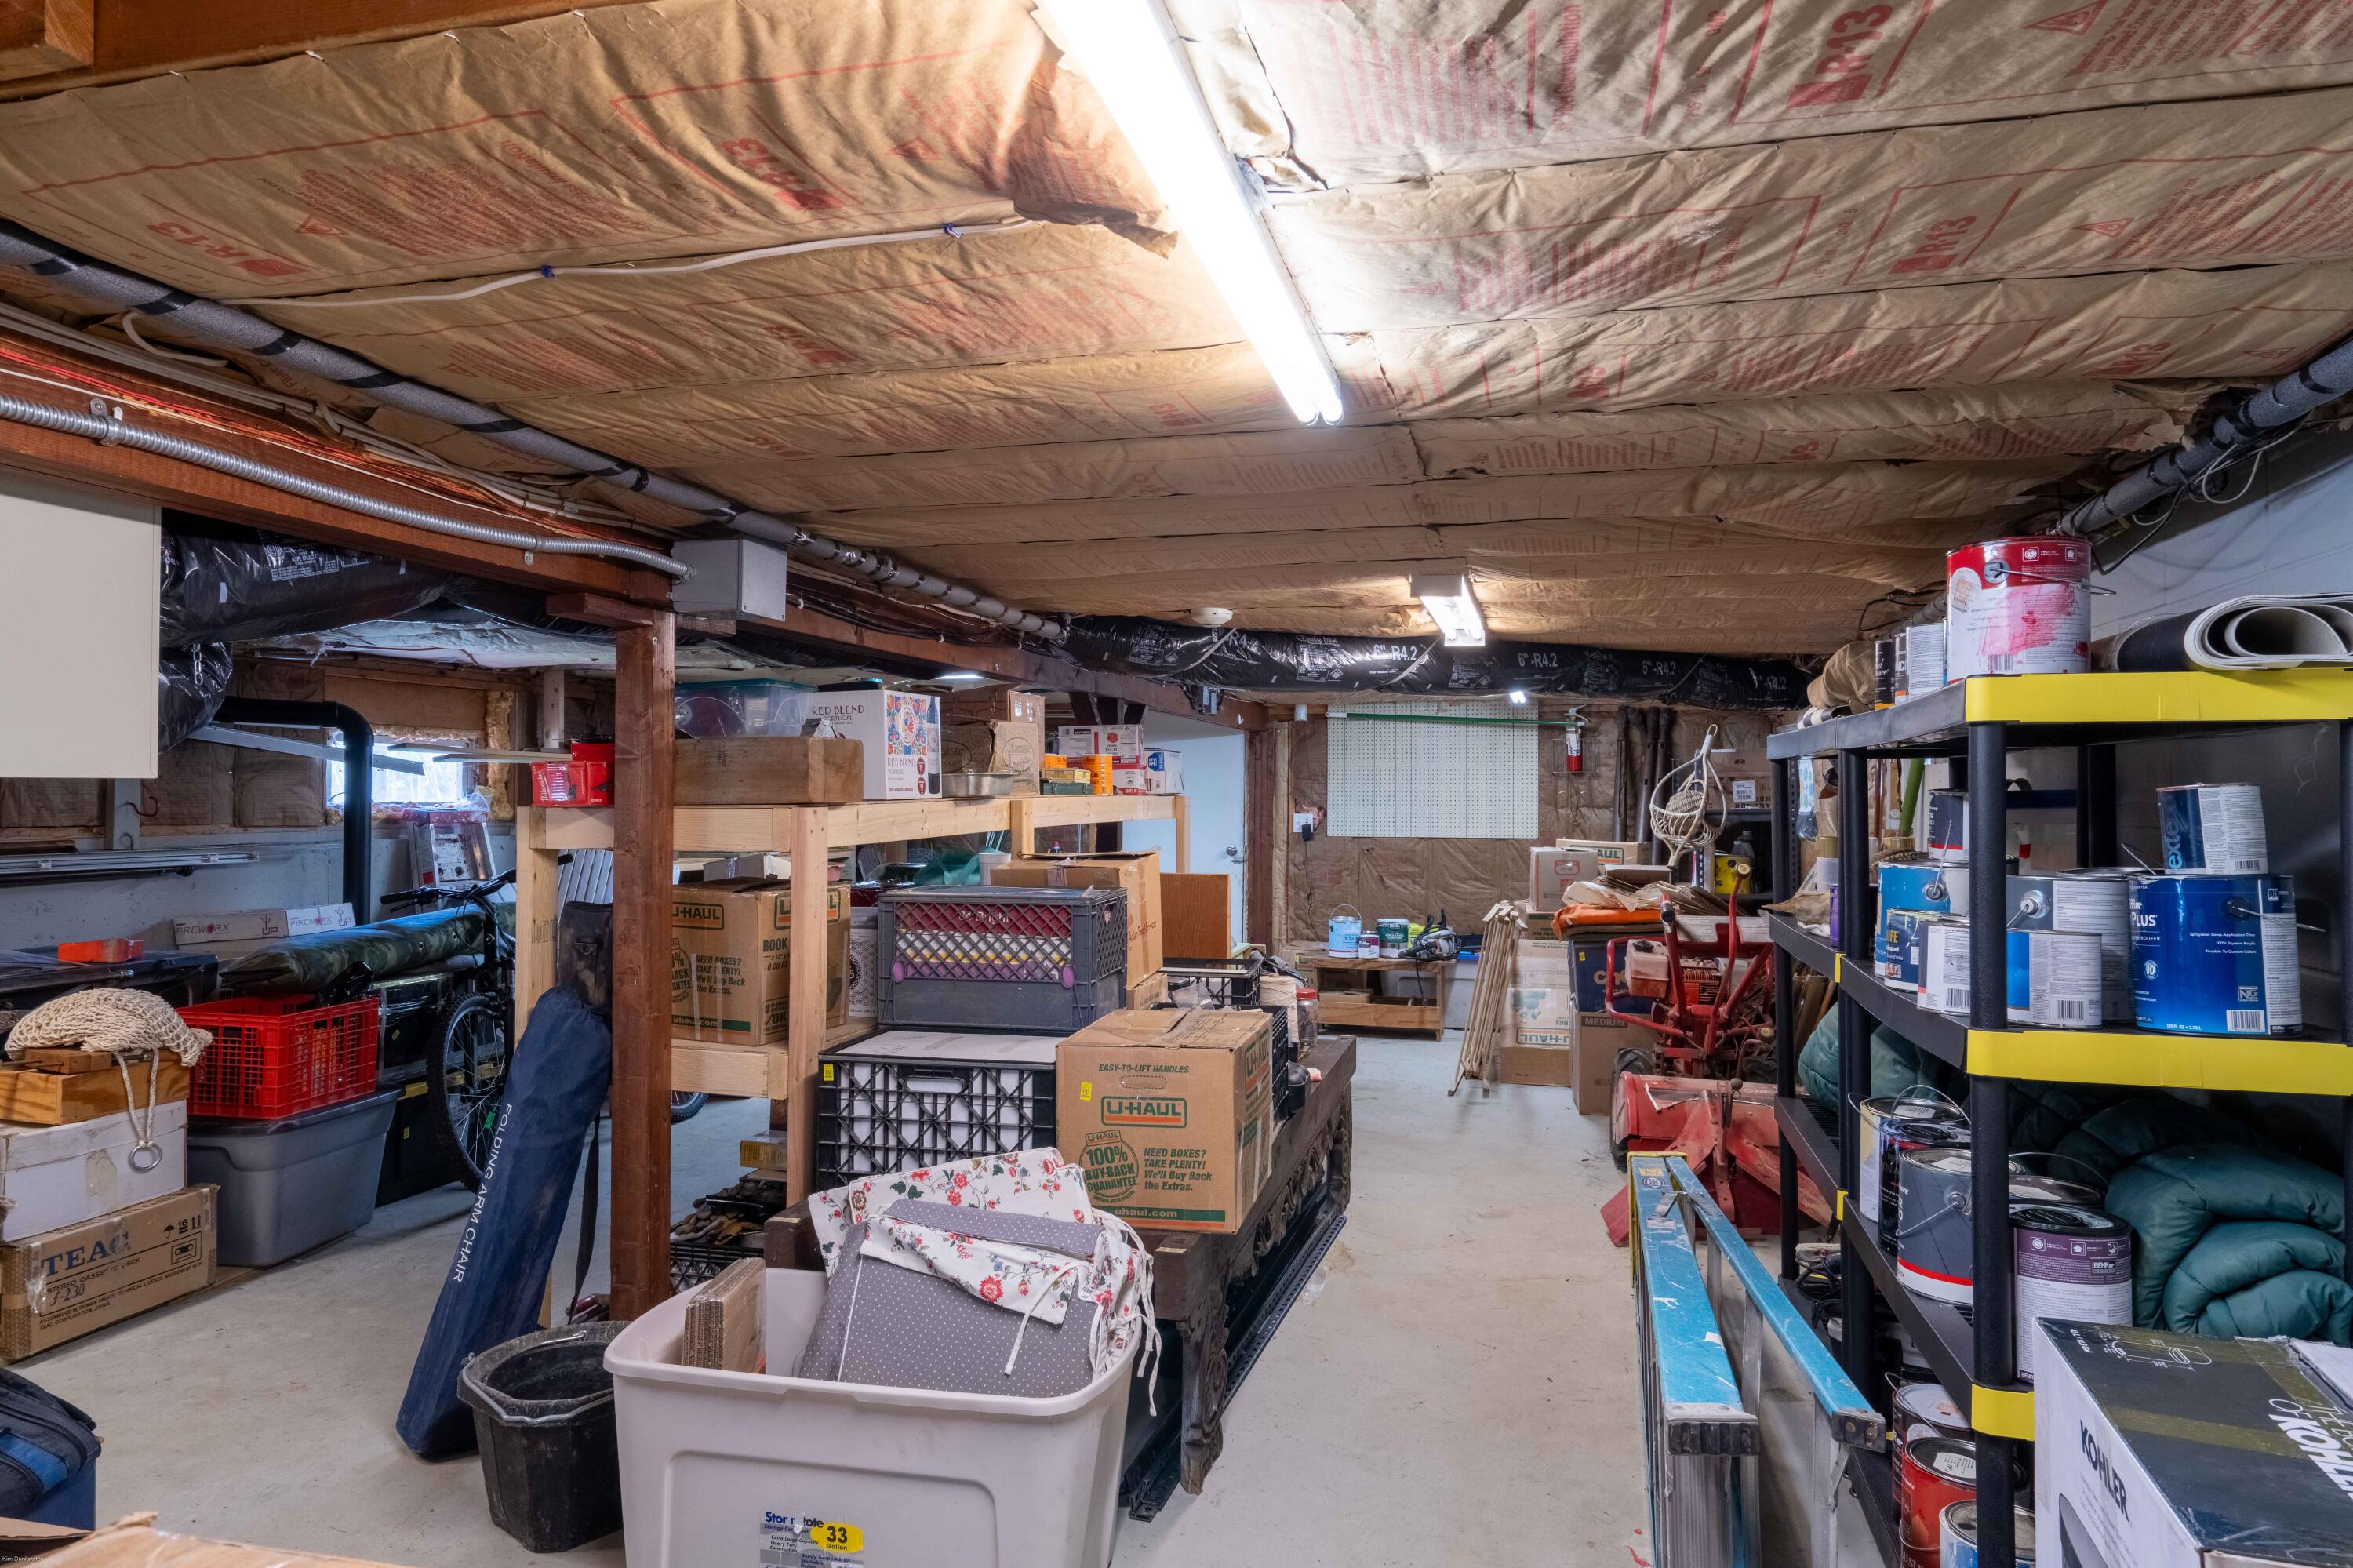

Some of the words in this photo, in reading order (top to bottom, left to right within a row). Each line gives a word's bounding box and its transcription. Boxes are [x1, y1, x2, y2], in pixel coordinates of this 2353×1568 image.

[1815, 4, 1893, 75] R-13
[722, 137, 806, 185] R-13
[147, 221, 249, 259] R-13
[1915, 216, 1977, 254] R-13
[1518, 652, 1529, 667] 6"
[1642, 660, 1652, 675] 6"
[812, 706, 831, 715] RED
[834, 705, 865, 715] BLEND
[888, 757, 899, 767] RED
[900, 757, 915, 767] BLEND
[1148, 757, 1155, 766] 33
[2132, 911, 2156, 927] PLUS
[762, 938, 788, 952] BOOK
[696, 955, 713, 964] NEED
[696, 965, 712, 973] TAKE
[714, 966, 740, 976] PENTY!
[2145, 964, 2155, 975] 10
[728, 977, 745, 986] Back
[1584, 1017, 1624, 1027] MEDIUM
[1099, 1064, 1151, 1072] EASY-TO-LIFT
[1107, 1101, 1182, 1116] U-HAUL
[484, 1103, 513, 1180] FOLDING
[1088, 1130, 1119, 1141] U-HAUL
[1086, 1145, 1128, 1166] 100%
[1144, 1148, 1168, 1157] NEED
[1170, 1148, 1206, 1159] BOXES?
[1085, 1163, 1135, 1181] BUY-BACK
[1144, 1159, 1166, 1168] TAKE
[1169, 1160, 1206, 1170] PLENTY!
[1144, 1170, 1166, 1179] We'll
[1169, 1171, 1187, 1181] Buy
[1189, 1172, 1212, 1181] Back
[1087, 1177, 1137, 1192] GUARANTEE
[1144, 1181, 1159, 1190] the
[1162, 1182, 1193, 1191] Extras.
[471, 1183, 488, 1224] ARM
[1115, 1208, 1178, 1217] uhaul.com
[179, 1218, 187, 1227] 16
[41, 1231, 129, 1278] TEAC
[453, 1228, 475, 1282] CHAIR
[46, 1279, 76, 1294] STEREO
[80, 1266, 118, 1282] CASSETTE
[121, 1258, 141, 1268] DECK
[39, 1309, 71, 1325] ASSEMBLED
[144, 1276, 163, 1288] LICENSE
[164, 1266, 191, 1280] AGREEMENT
[39, 1321, 53, 1330] TEAC
[2268, 1414, 2353, 1501] KOHLE
[2079, 1419, 2130, 1523] KOHLER
[766, 1511, 788, 1524] Stor
[827, 1526, 848, 1544] 33
